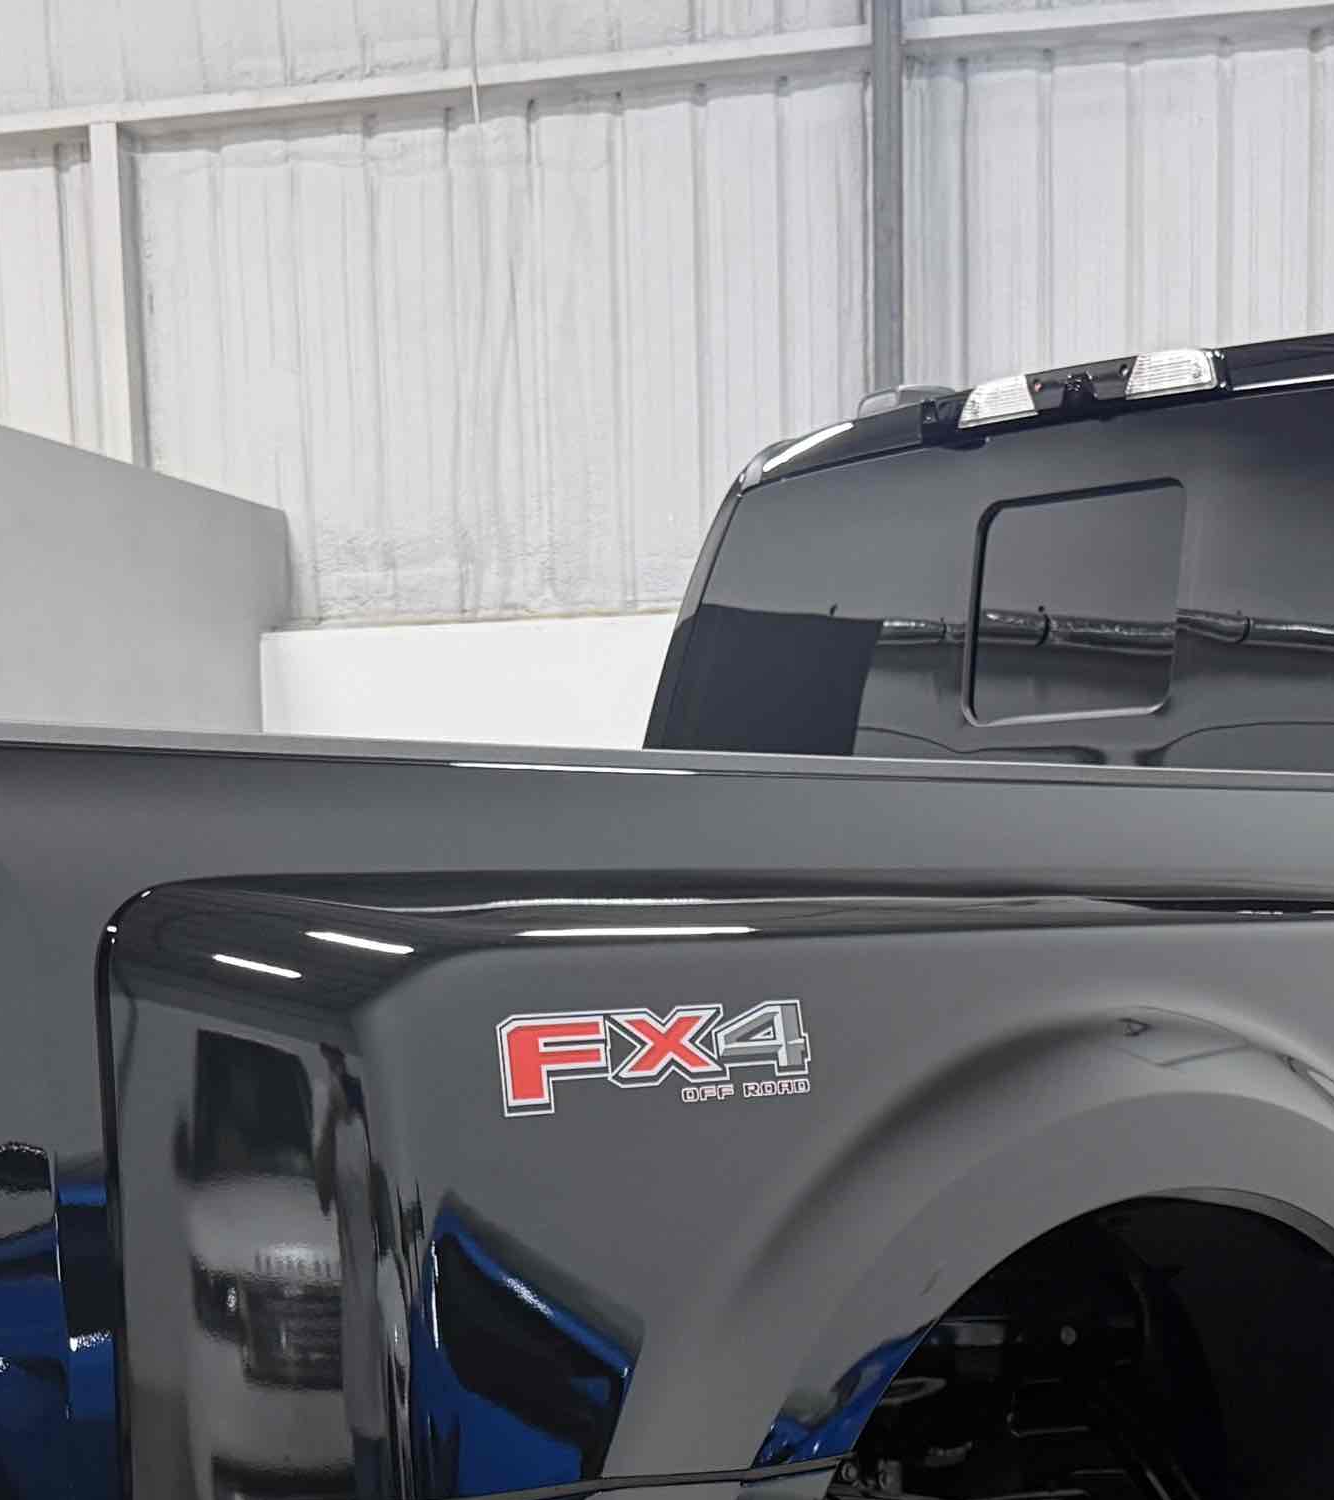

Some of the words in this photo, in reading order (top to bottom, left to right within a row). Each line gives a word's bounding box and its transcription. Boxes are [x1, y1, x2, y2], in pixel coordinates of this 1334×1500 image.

[496, 1000, 811, 1117] FX4
[681, 1085, 734, 1103] OFF
[742, 1079, 811, 1098] ROAD
